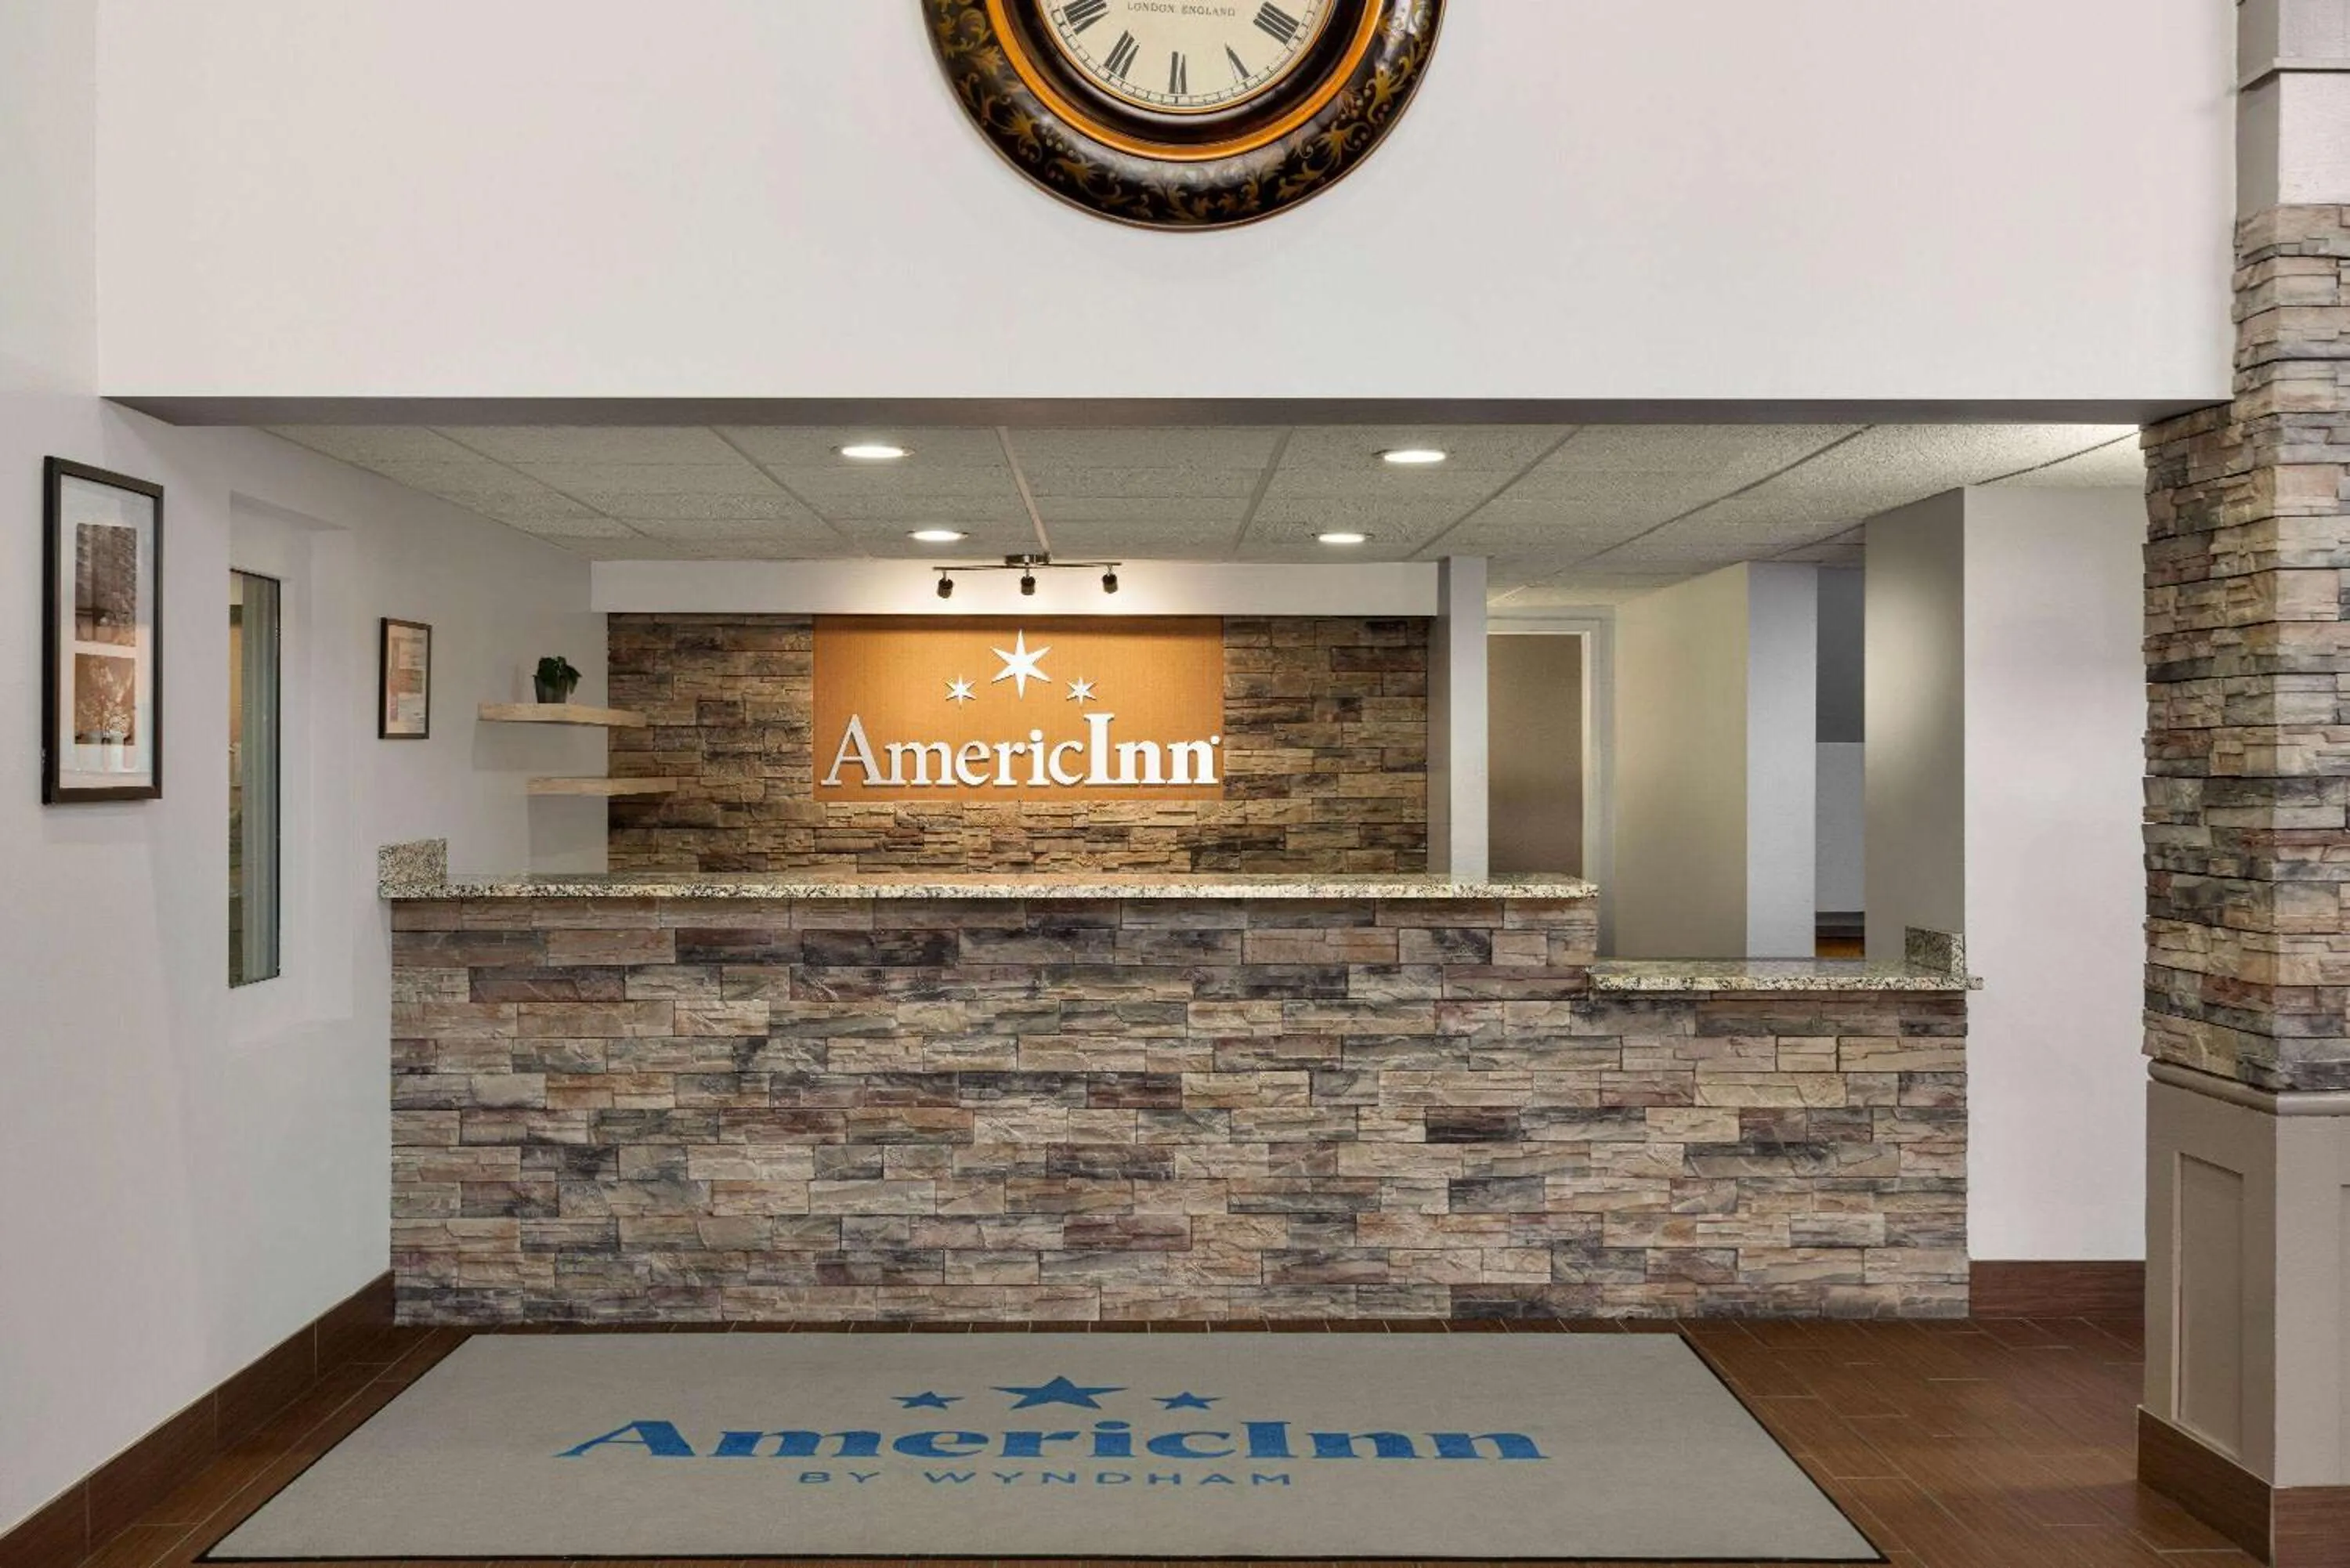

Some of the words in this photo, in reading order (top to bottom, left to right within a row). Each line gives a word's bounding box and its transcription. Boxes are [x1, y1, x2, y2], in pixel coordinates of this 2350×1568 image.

[1127, 2, 1174, 13] LONDON
[1181, 5, 1235, 16] ENGLAND
[821, 711, 1220, 786] AmericInn
[553, 1420, 1549, 1460] AmericInn
[798, 1471, 880, 1485] BY
[924, 1472, 1292, 1486] WYNDHAM
